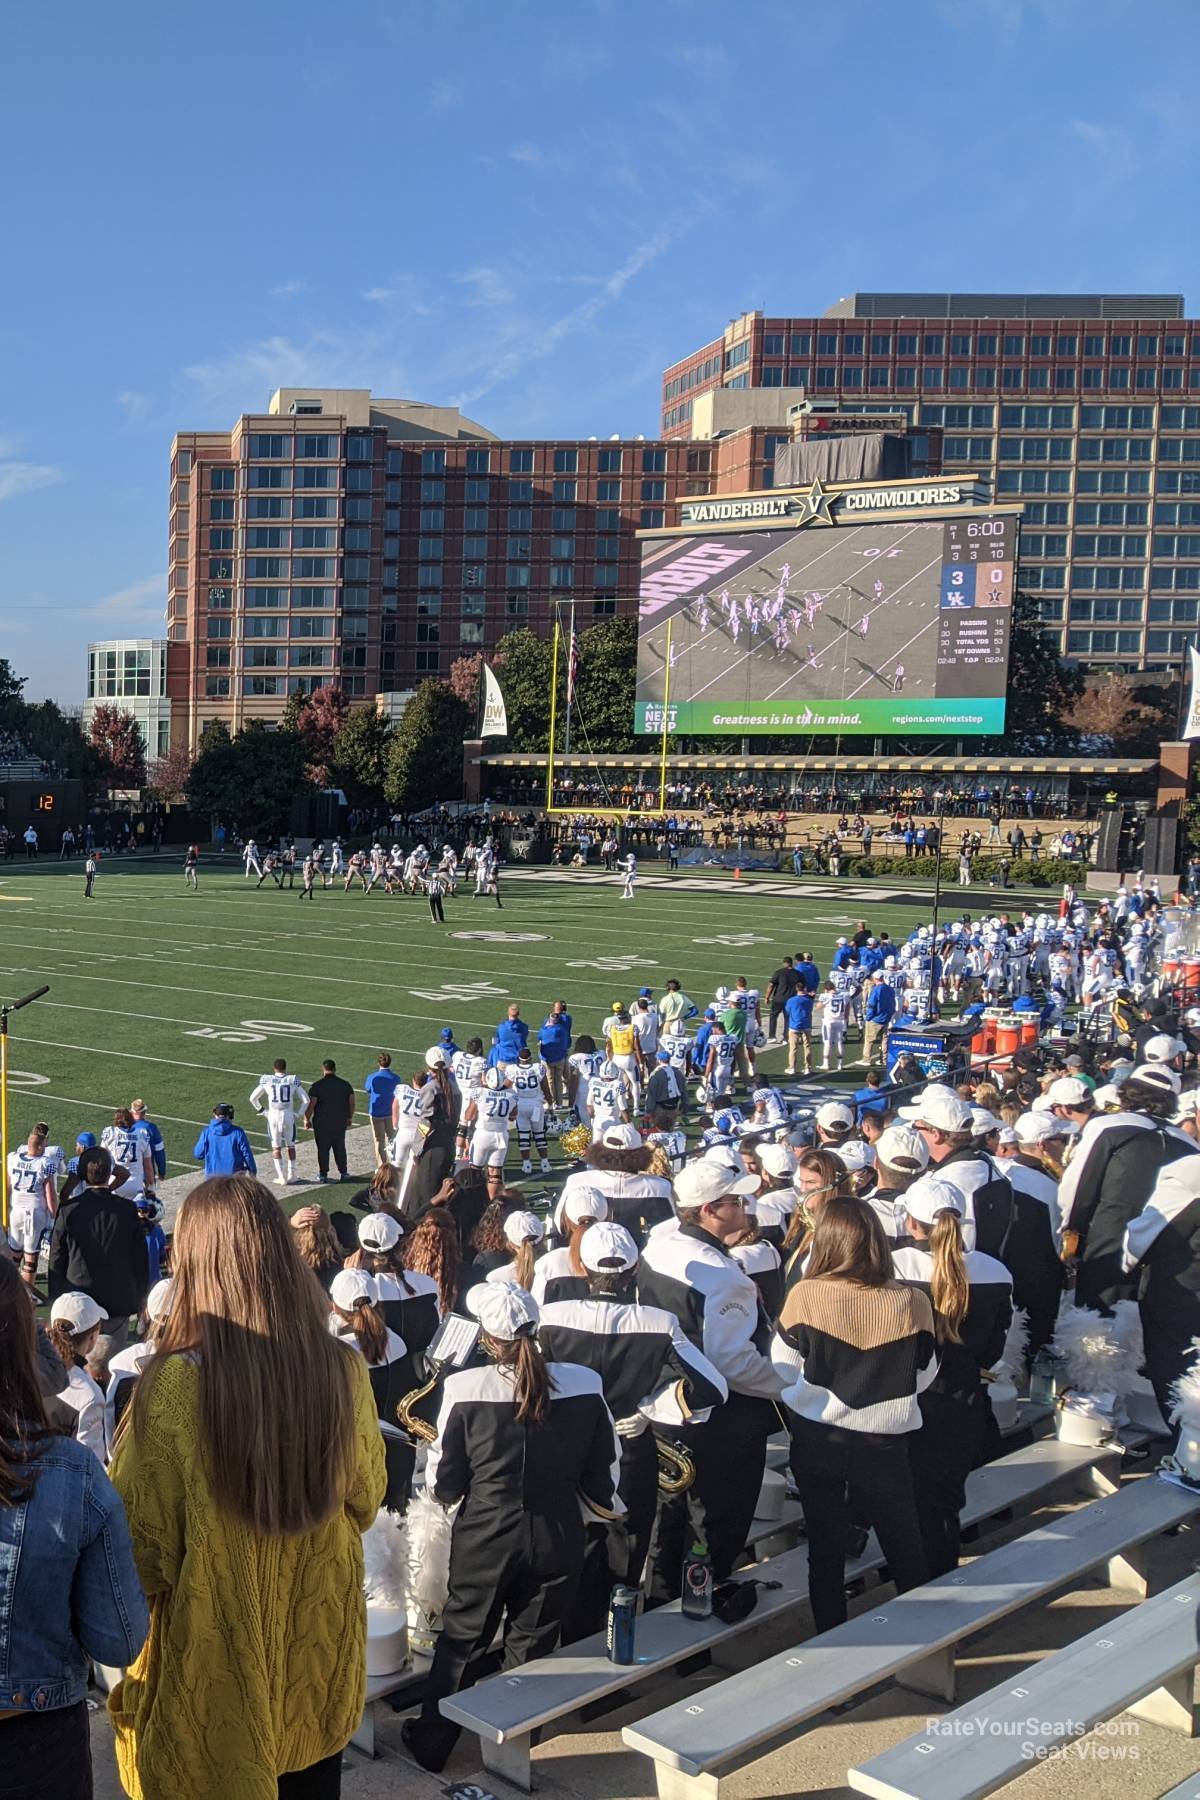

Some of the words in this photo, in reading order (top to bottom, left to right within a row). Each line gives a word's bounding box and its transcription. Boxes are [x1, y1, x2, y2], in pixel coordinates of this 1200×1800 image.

[807, 496, 821, 514] V
[846, 487, 960, 509] COMMODORES
[689, 500, 788, 521] VANDERBILT
[967, 521, 1004, 537] 6:00
[952, 552, 960, 561] 3
[970, 551, 977, 560] 3
[991, 549, 1004, 559] 10
[951, 571, 964, 585] 3
[990, 569, 1003, 583] 0
[486, 705, 503, 718] DW
[645, 710, 678, 722] NEXT
[712, 714, 768, 725] Greatness
[770, 714, 779, 725] is
[782, 714, 793, 725] in
[813, 713, 824, 725] in
[828, 713, 862, 725] mind.
[892, 714, 983, 724] regions.com/nextstep
[645, 722, 677, 733] STEP
[40, 795, 53, 810] 12
[408, 983, 510, 1001] 40
[182, 1020, 315, 1043] 50
[667, 1042, 687, 1059] 33
[272, 1085, 290, 1103] 10
[593, 1088, 614, 1107] 24
[486, 1098, 510, 1118] 70
[118, 1141, 138, 1162] 71
[13, 1168, 38, 1193] 77
